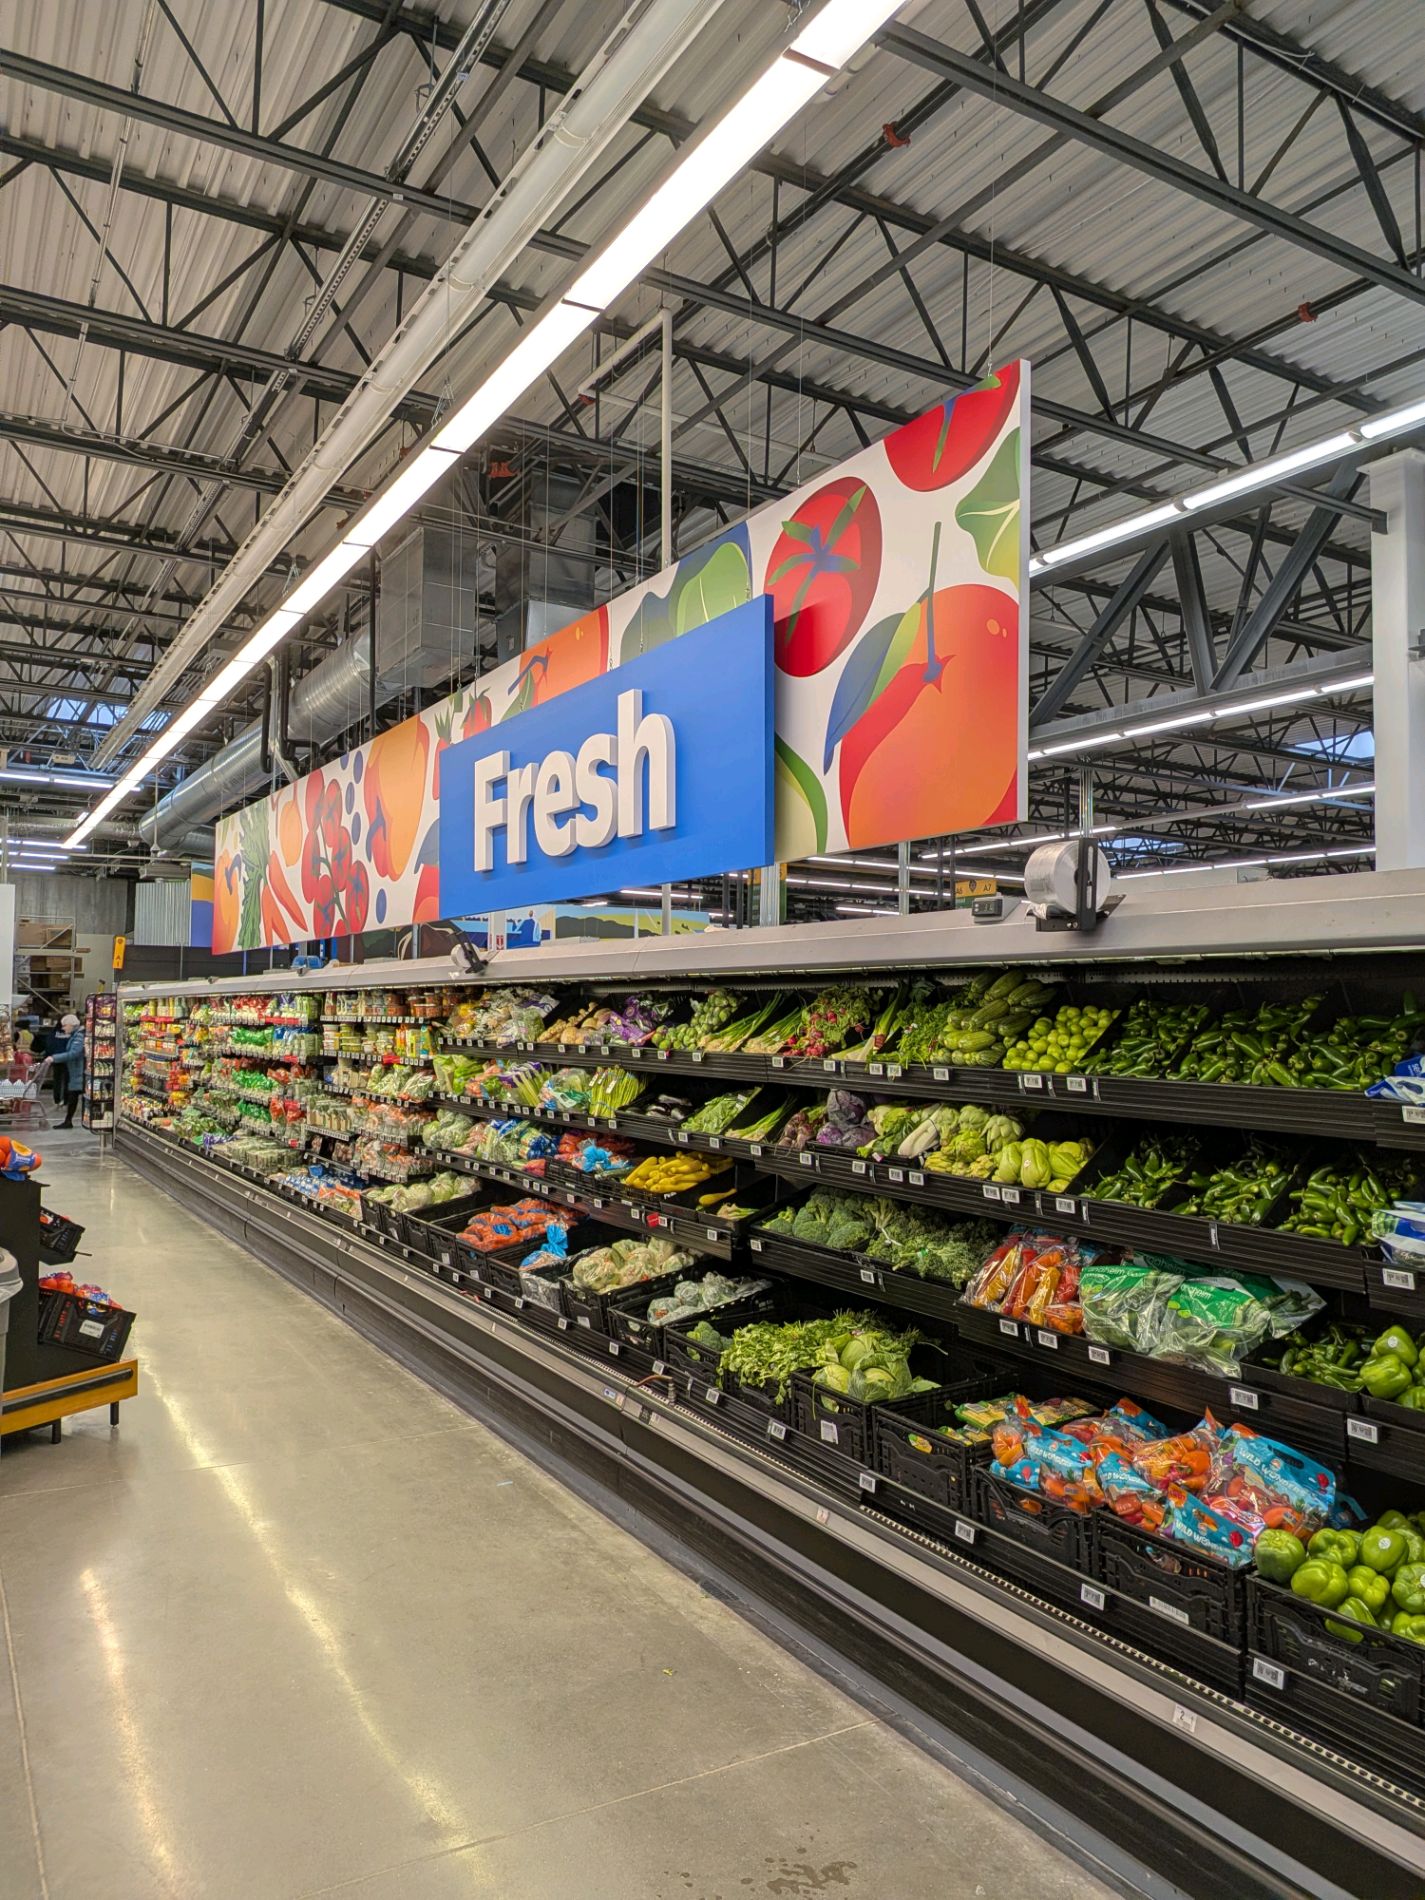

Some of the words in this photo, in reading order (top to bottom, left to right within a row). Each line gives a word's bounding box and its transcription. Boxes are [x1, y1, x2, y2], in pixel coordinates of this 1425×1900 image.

[474, 688, 677, 873] Fresh
[1239, 1447, 1262, 1466] WILD
[1175, 1518, 1194, 1537] WILD
